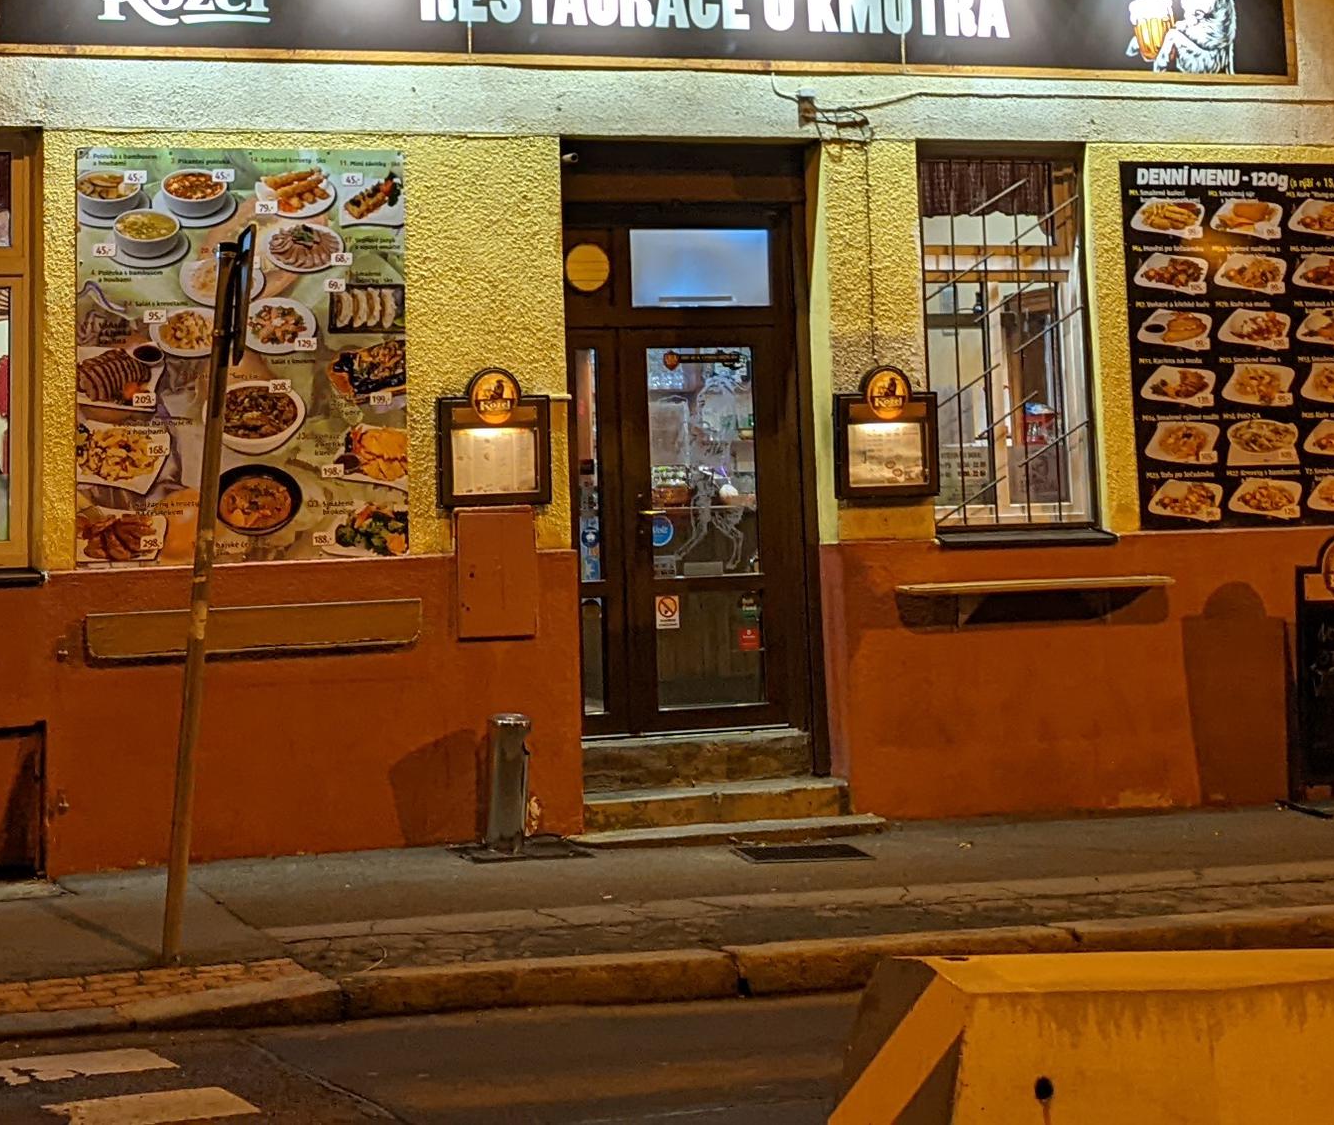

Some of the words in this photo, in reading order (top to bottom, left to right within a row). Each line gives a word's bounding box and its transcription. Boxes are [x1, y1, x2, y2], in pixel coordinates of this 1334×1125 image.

[1137, 166, 1189, 185] DENNÍ
[1190, 169, 1240, 186] MENU
[1251, 172, 1288, 192] 120g
[479, 400, 511, 411] Kozel
[874, 396, 902, 408] Kozel
